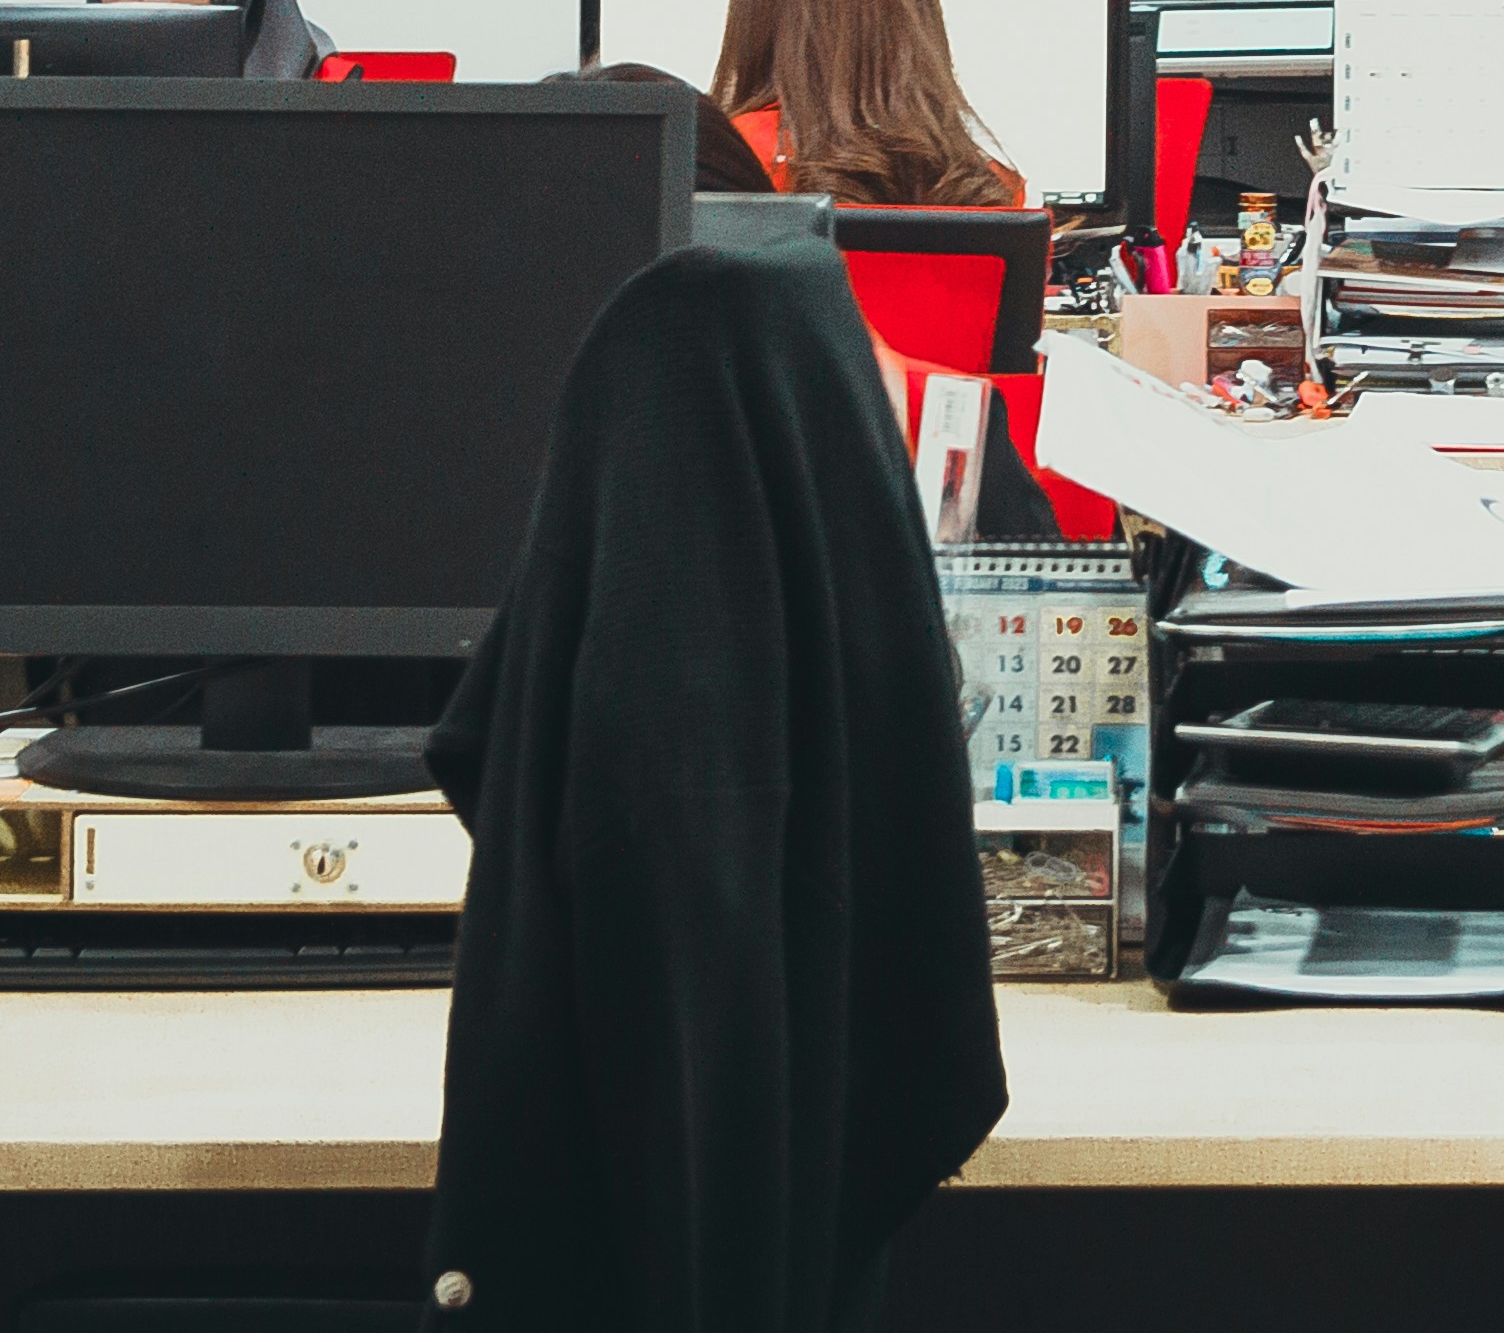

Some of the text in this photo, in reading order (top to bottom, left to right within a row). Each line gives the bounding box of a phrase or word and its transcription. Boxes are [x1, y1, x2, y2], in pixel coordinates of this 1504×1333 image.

[998, 615, 1138, 636] 12 19 26
[998, 654, 1137, 674] 13 20 27
[997, 695, 1136, 714] 14 21 28
[996, 734, 1079, 754] 15 22
